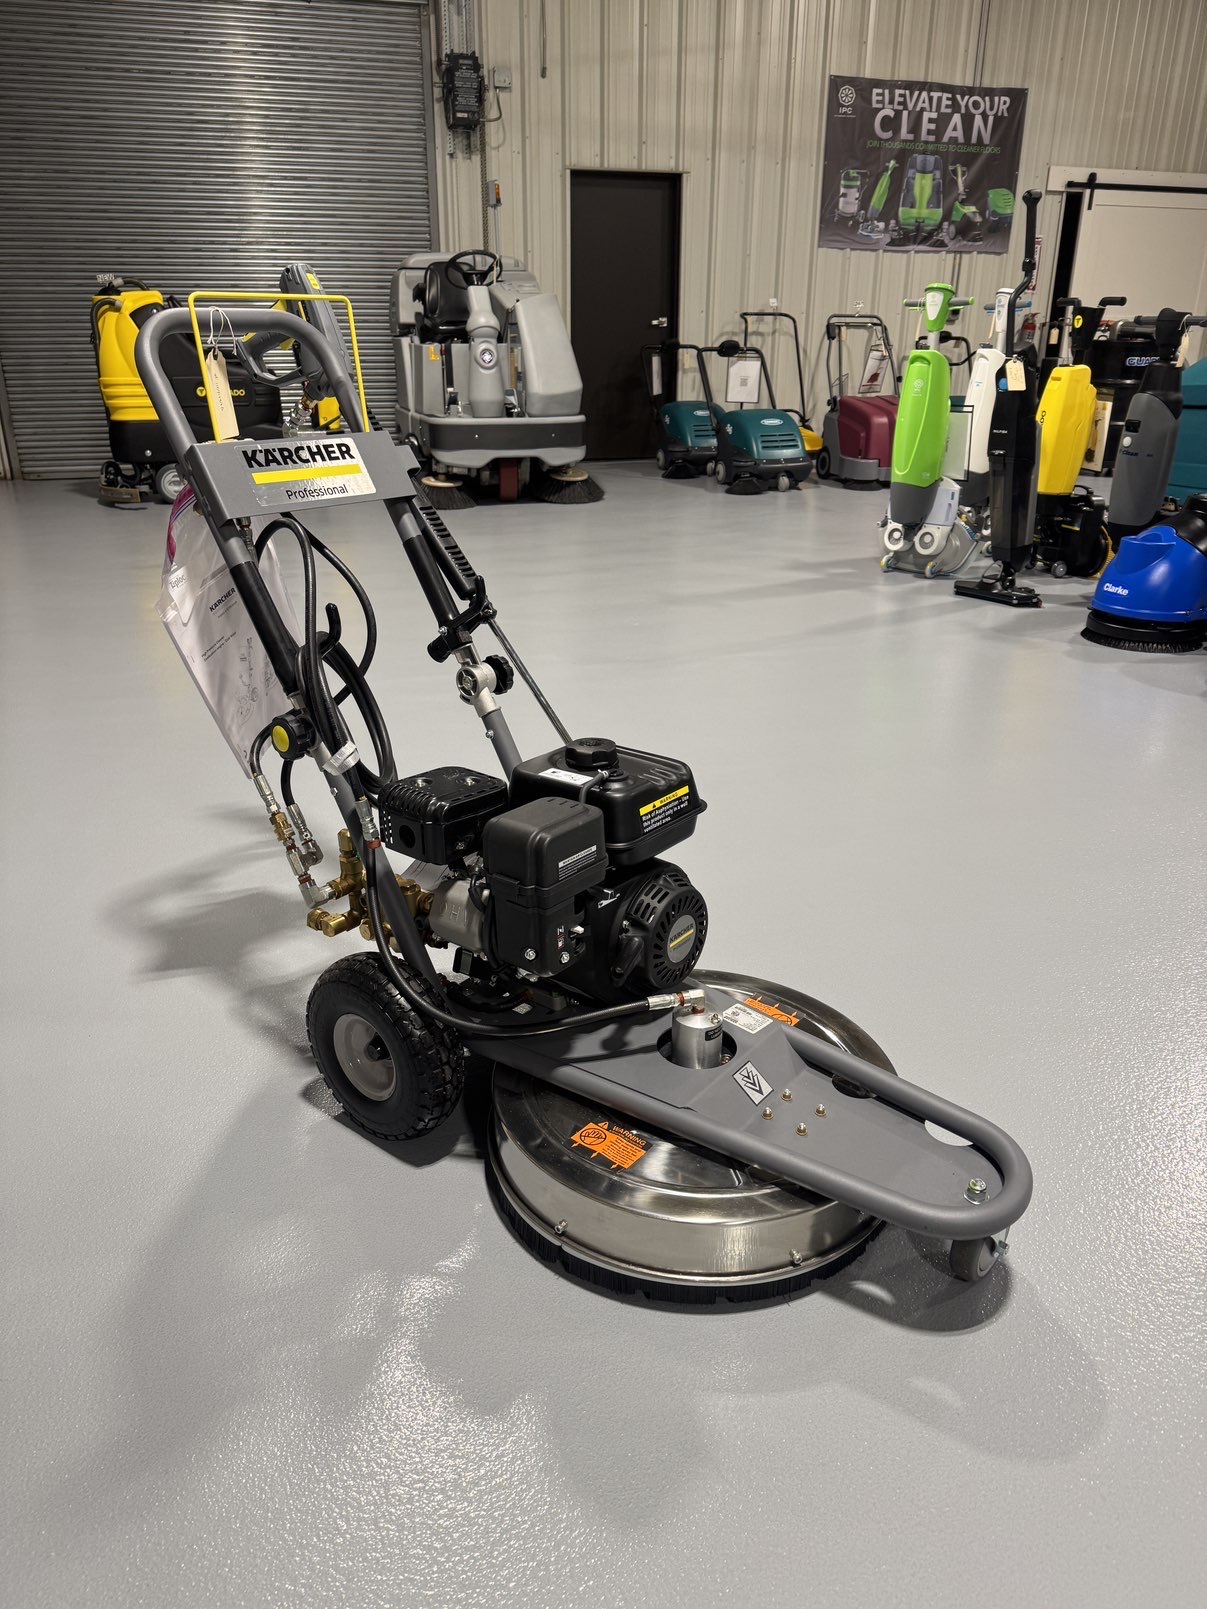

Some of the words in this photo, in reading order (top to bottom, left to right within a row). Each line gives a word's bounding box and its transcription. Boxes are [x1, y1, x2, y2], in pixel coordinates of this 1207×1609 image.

[872, 88, 952, 113] ELEVATE
[956, 94, 1010, 116] YOUR
[874, 108, 994, 144] CLEAN
[880, 141, 914, 150] THOUSANDS
[242, 442, 356, 468] KÄRCHER
[286, 484, 348, 500] Professional
[1104, 582, 1128, 596] Clarke
[651, 813, 665, 824] product
[612, 1126, 646, 1146] WARNING
